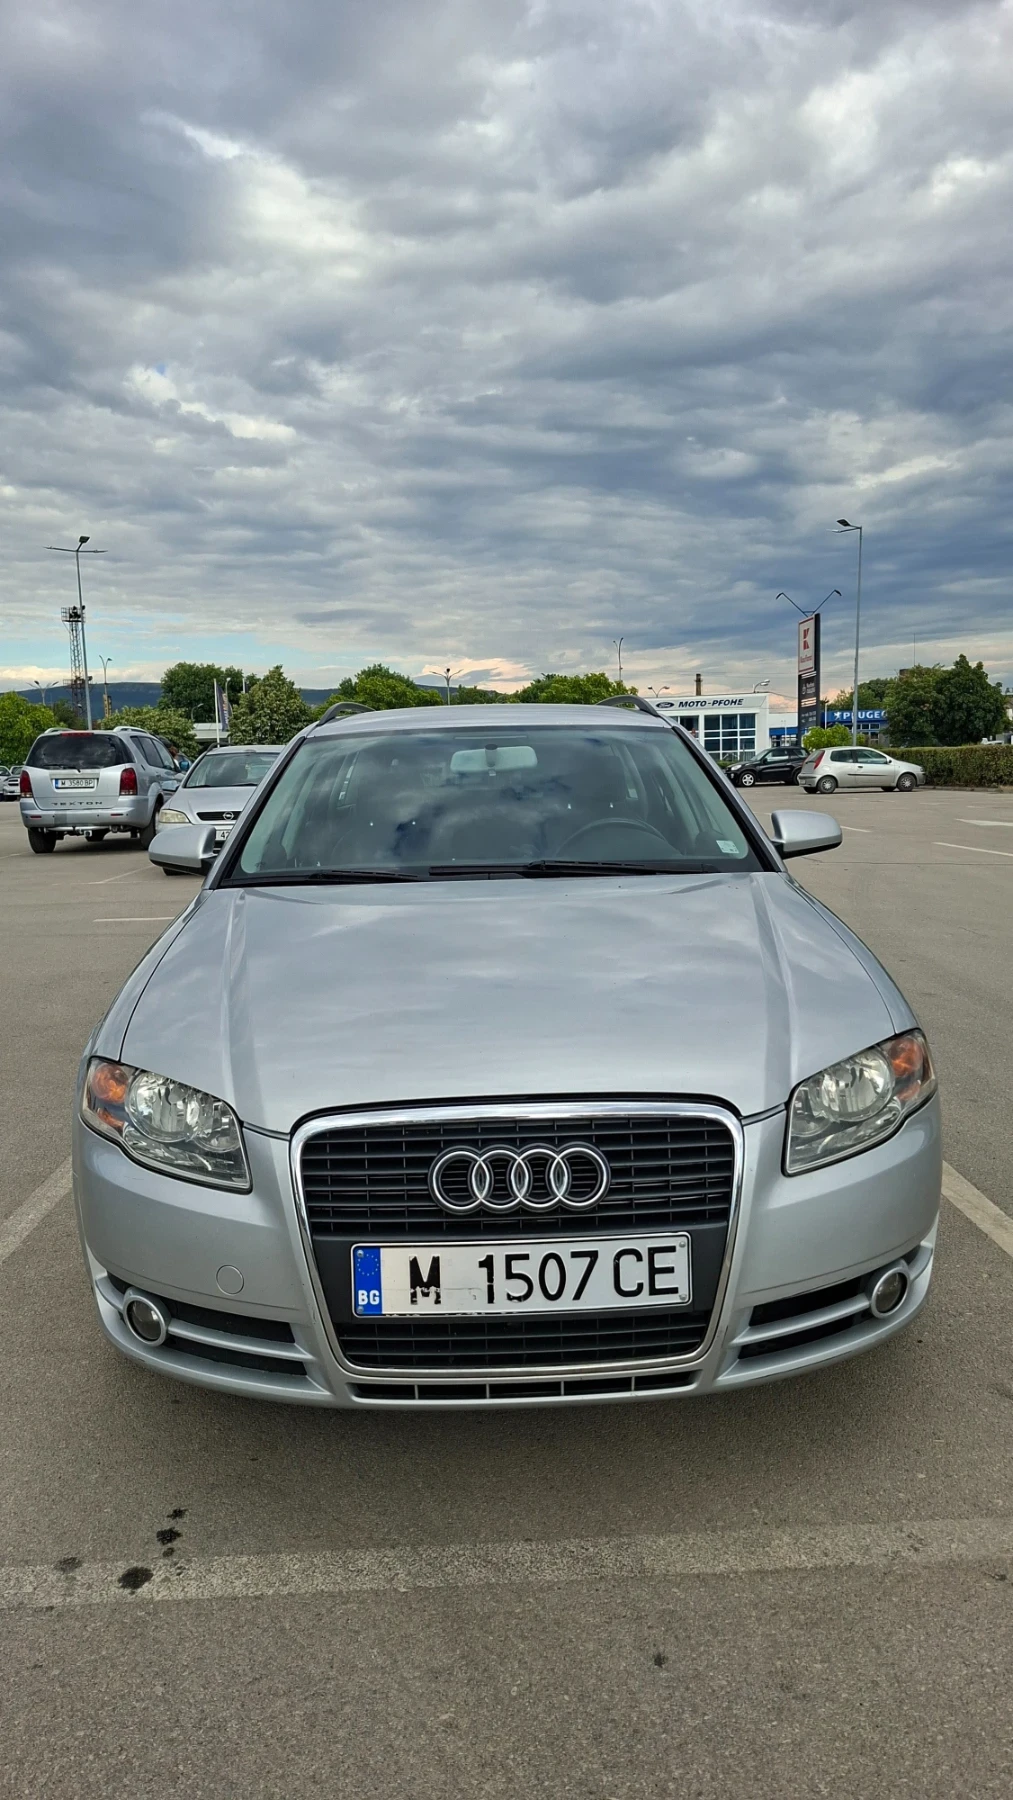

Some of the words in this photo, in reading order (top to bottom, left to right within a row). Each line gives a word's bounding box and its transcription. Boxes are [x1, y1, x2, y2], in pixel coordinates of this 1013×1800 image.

[678, 698, 744, 708] MOTO-PFOHE
[843, 711, 888, 719] PUGEO
[408, 1254, 441, 1305] M
[478, 1249, 599, 1305] 1507
[613, 1244, 679, 1298] CE
[358, 1289, 380, 1306] BG
